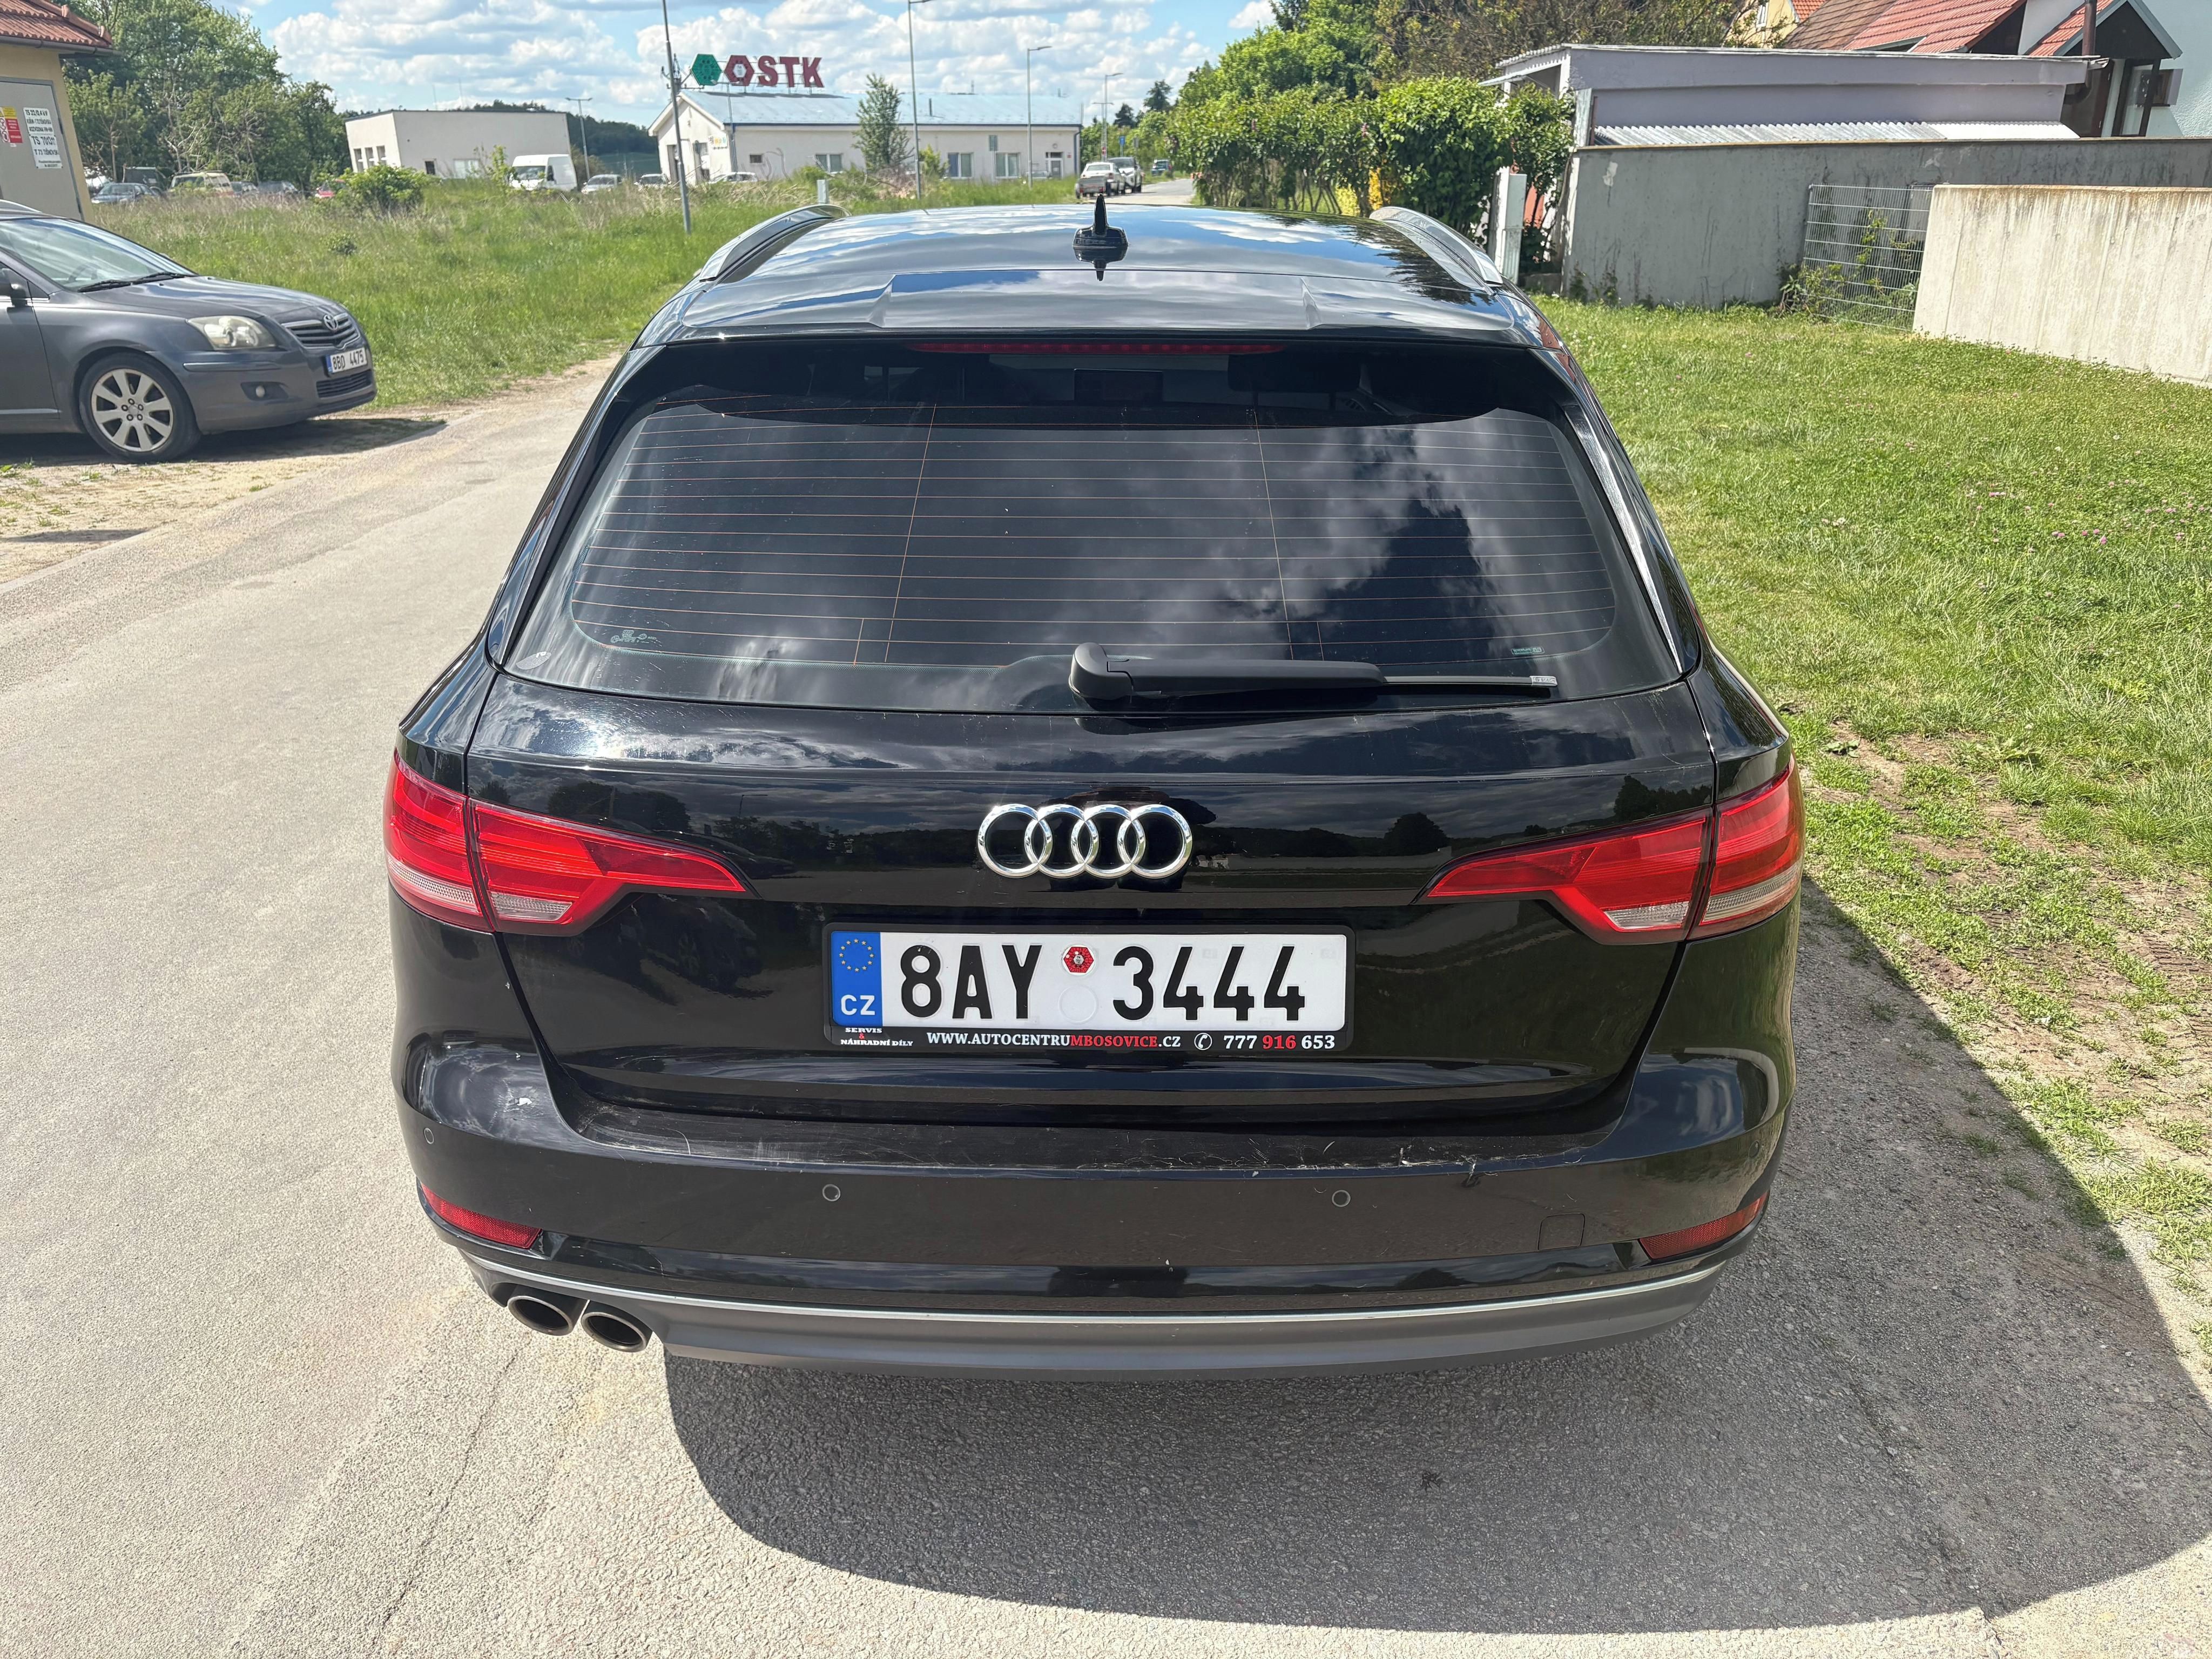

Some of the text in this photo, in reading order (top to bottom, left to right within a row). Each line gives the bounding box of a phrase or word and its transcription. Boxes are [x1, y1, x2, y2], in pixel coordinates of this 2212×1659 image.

[758, 56, 824, 87] STK
[900, 945, 1305, 1021] 8AY 3444
[841, 994, 875, 1015] CZ
[927, 1032, 1336, 1049] WWW.AUTOCENTRUMBOSOVICE.CZ 777 916 653
